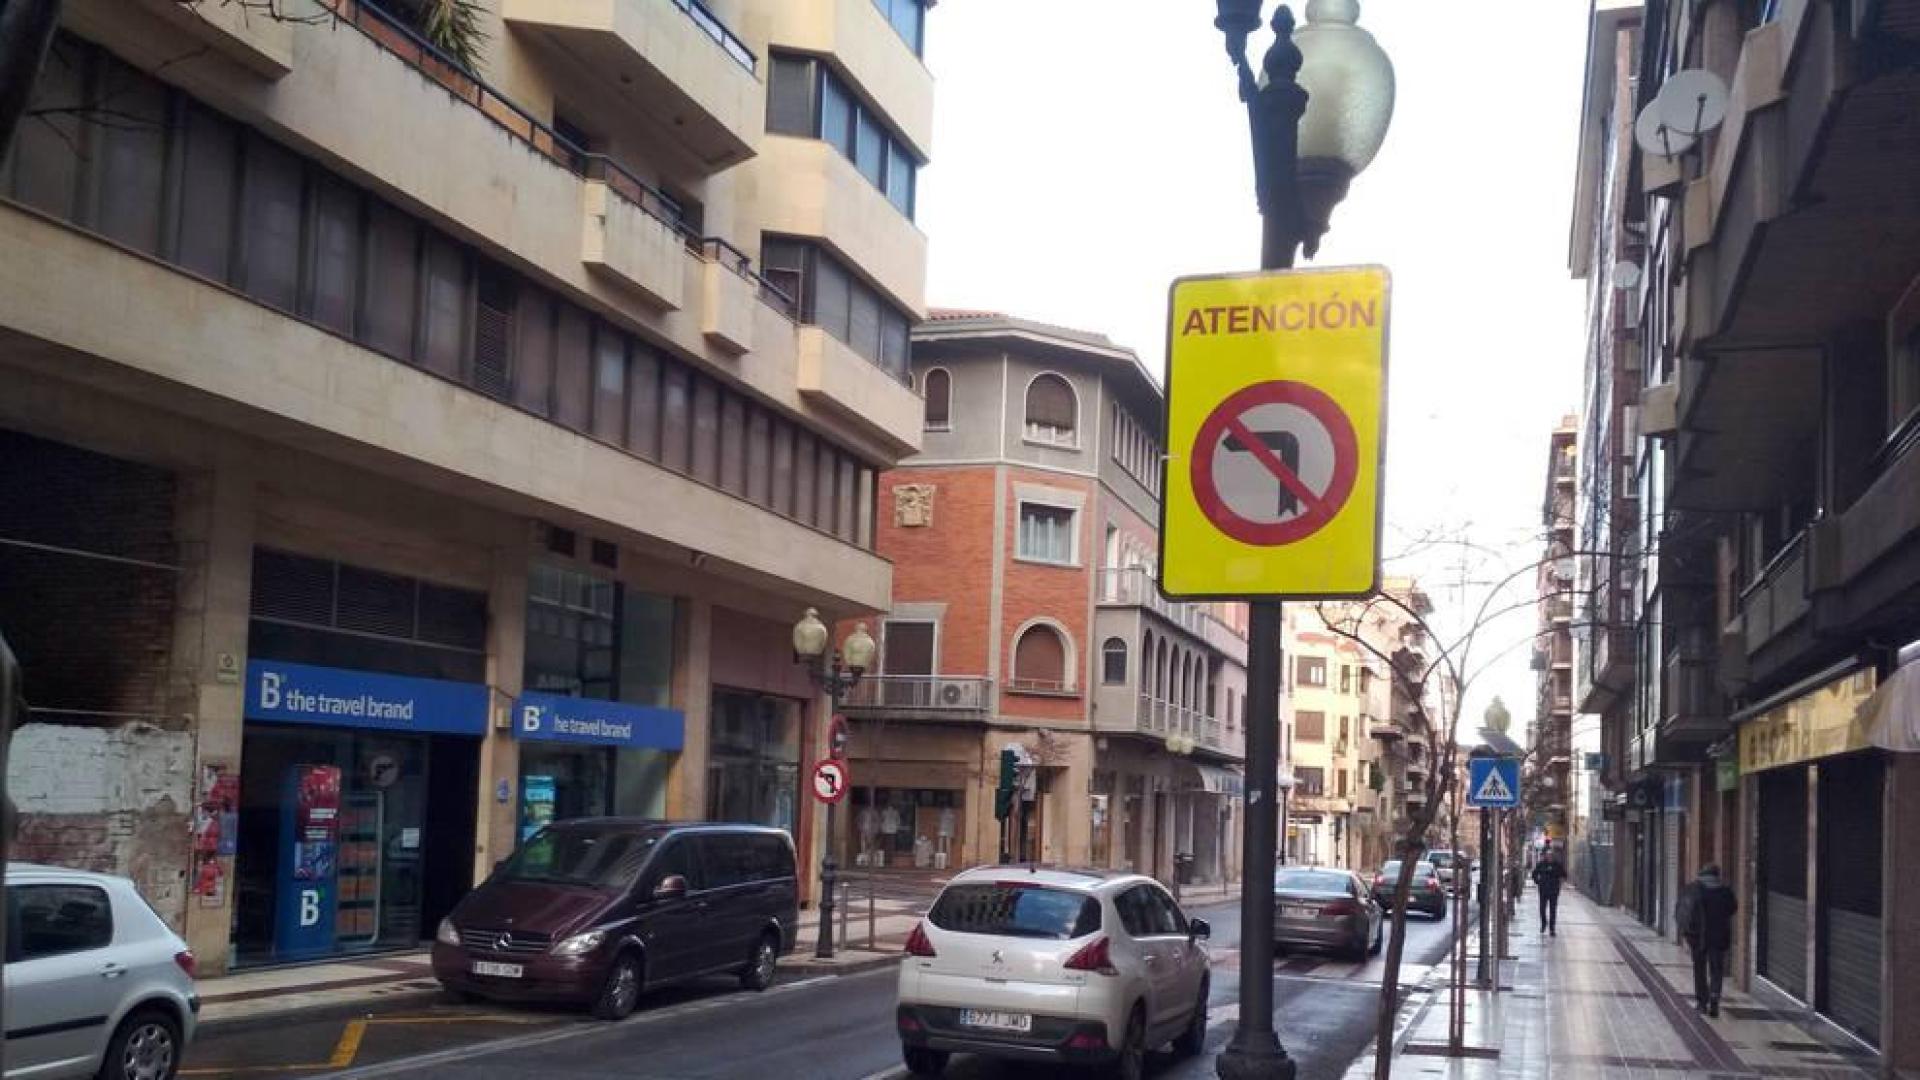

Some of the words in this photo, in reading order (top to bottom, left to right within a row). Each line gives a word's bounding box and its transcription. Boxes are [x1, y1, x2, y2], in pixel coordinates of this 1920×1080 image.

[1182, 293, 1376, 337] ATENCIÓN
[261, 671, 281, 710] B
[286, 689, 316, 713] the
[317, 692, 366, 717] travel
[367, 695, 414, 721] brand
[523, 705, 540, 732] B
[569, 718, 600, 736] travel
[601, 720, 632, 738] brand
[300, 889, 320, 926] B
